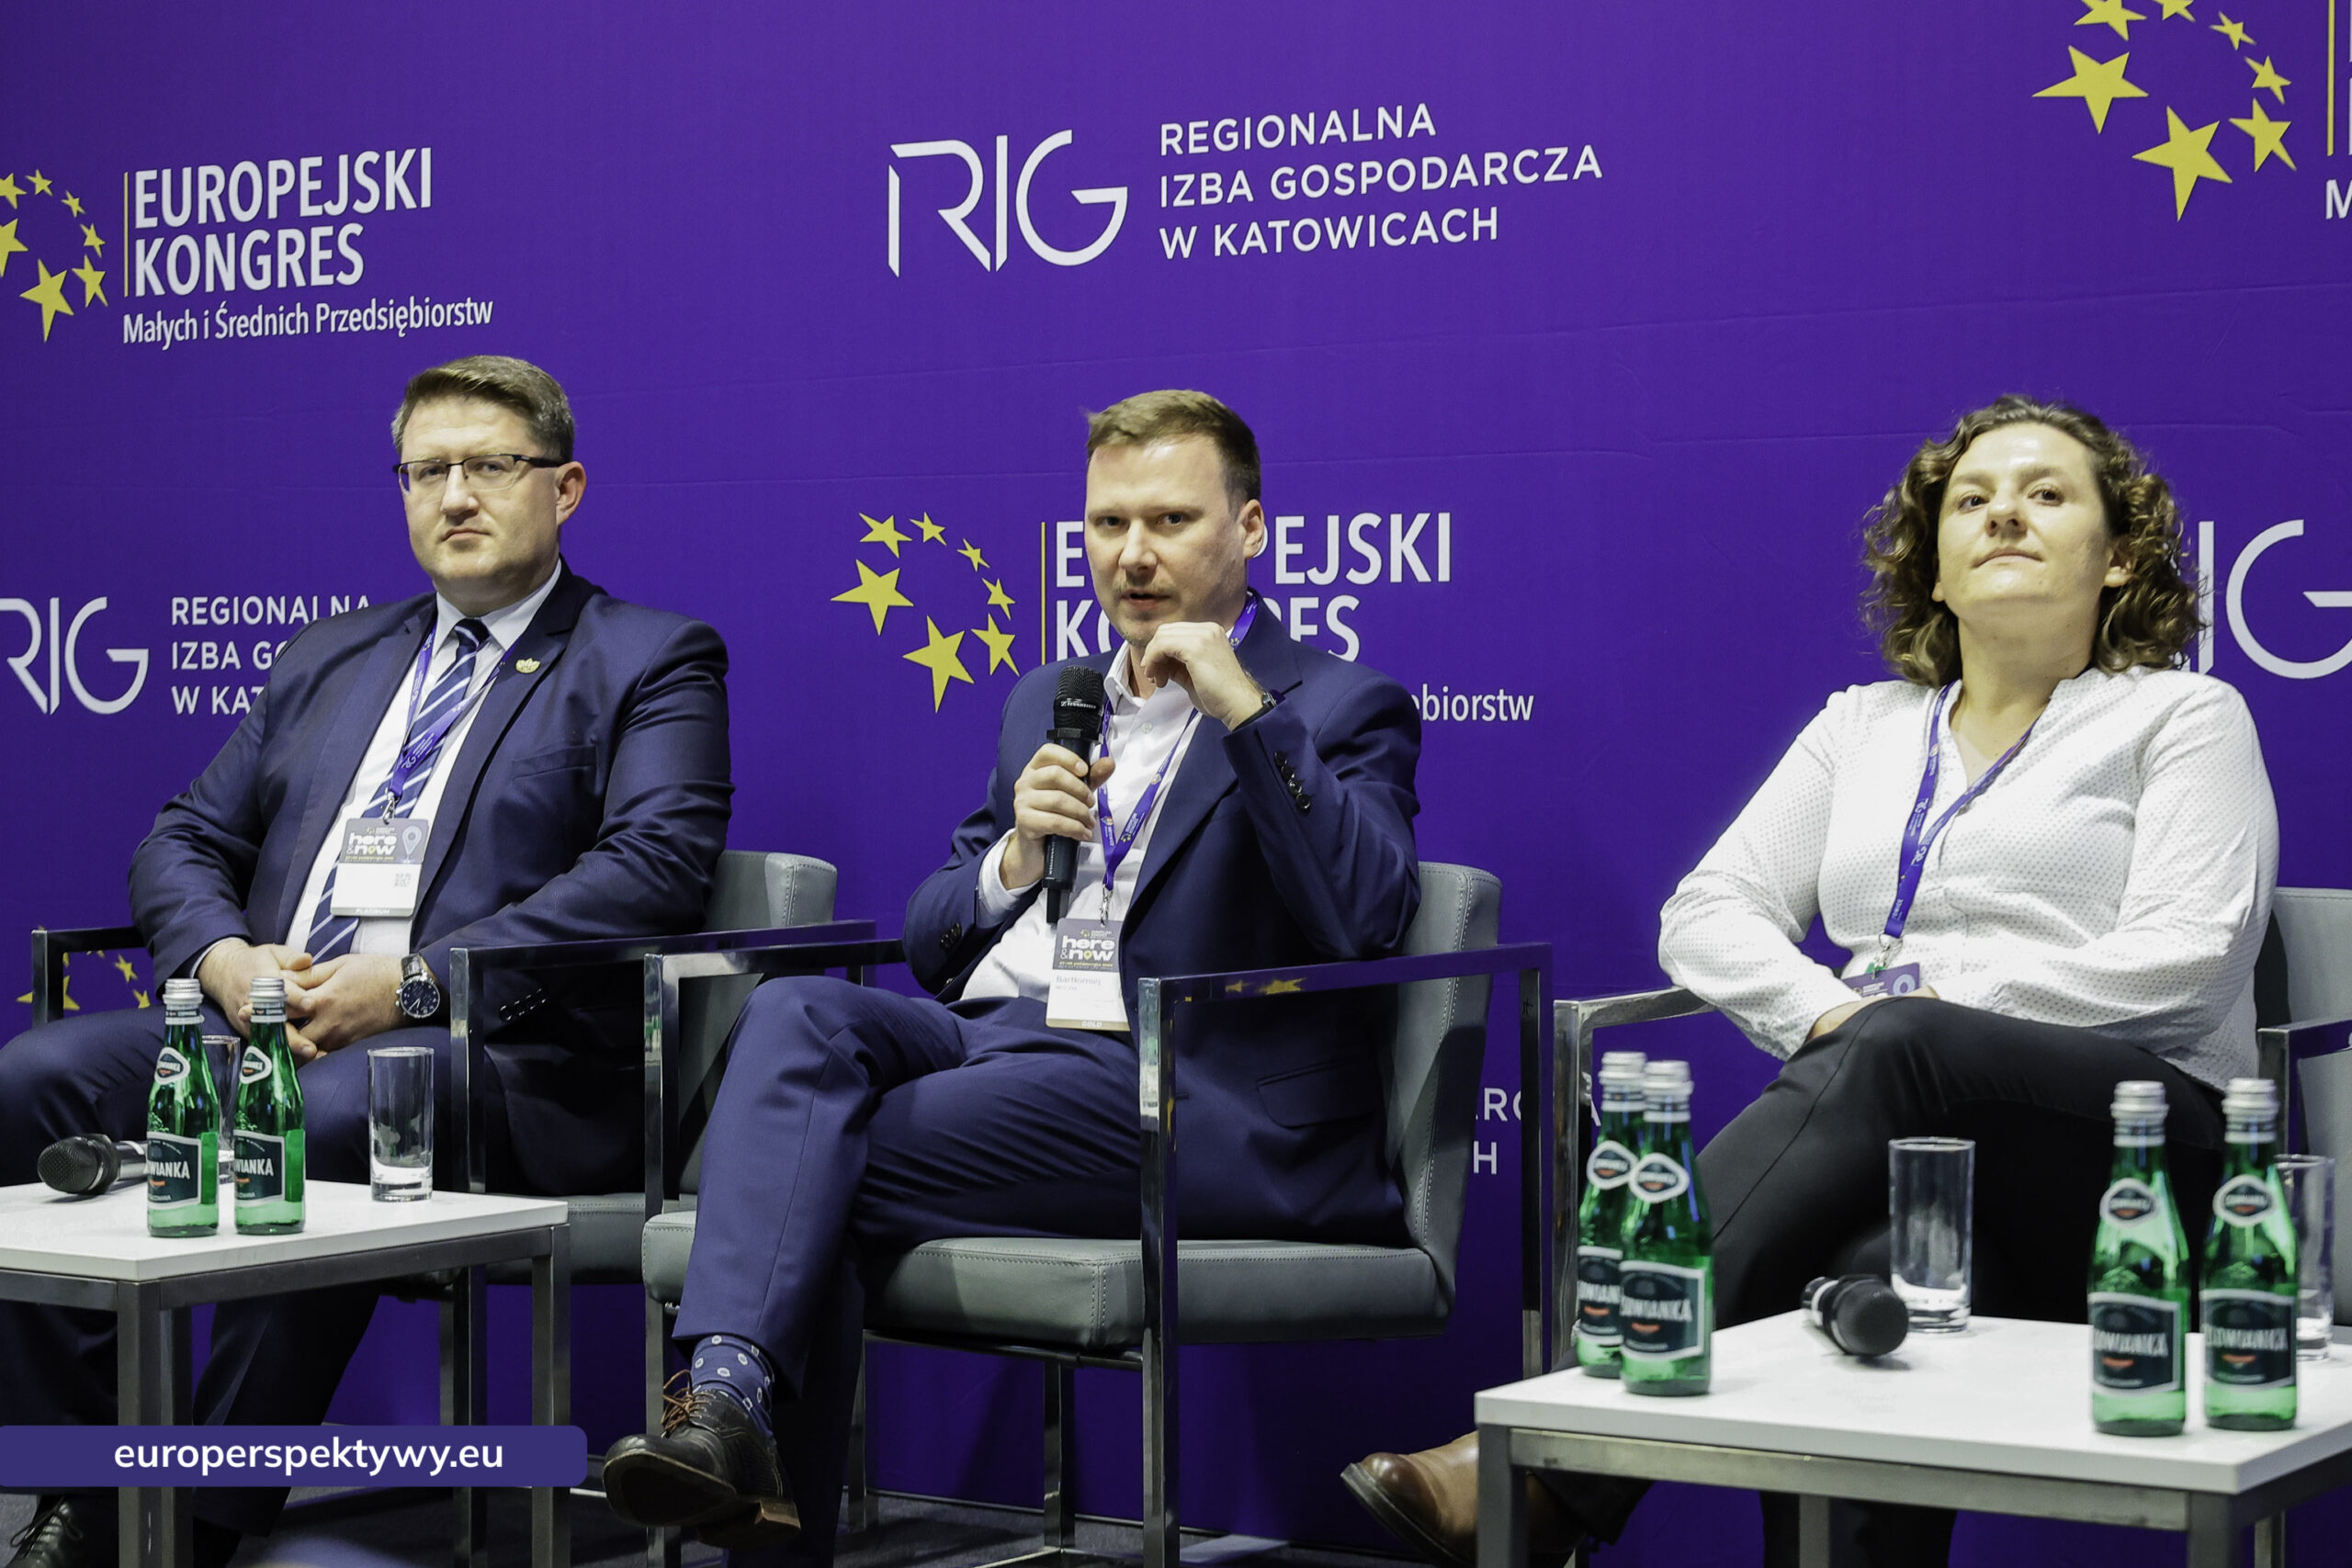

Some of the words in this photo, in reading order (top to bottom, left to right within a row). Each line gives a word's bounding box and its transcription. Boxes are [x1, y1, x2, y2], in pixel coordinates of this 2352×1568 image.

[1160, 102, 1437, 156] REGIONALNA
[134, 147, 432, 230] EUROPEJSKI
[888, 129, 1129, 277] RIG
[1160, 169, 1255, 209] IZBA
[1270, 144, 1603, 201] GOSPODARCZA
[134, 222, 364, 298] KONGRES
[1159, 225, 1198, 260] W
[1214, 206, 1498, 257] KATOWICACH
[123, 310, 198, 351] Małych
[203, 310, 209, 339] i
[214, 300, 310, 340] Średnich
[315, 297, 493, 337] Przedsiębiorstw
[2179, 519, 2352, 680] IG
[0, 596, 150, 716] RIG
[171, 640, 242, 671] IZBA
[171, 685, 200, 716] W
[348, 831, 398, 845] here
[1061, 934, 1115, 951] here
[1080, 1020, 1103, 1028] GOLD
[147, 1160, 191, 1180] WIANKA
[234, 1157, 275, 1177] WIANKA
